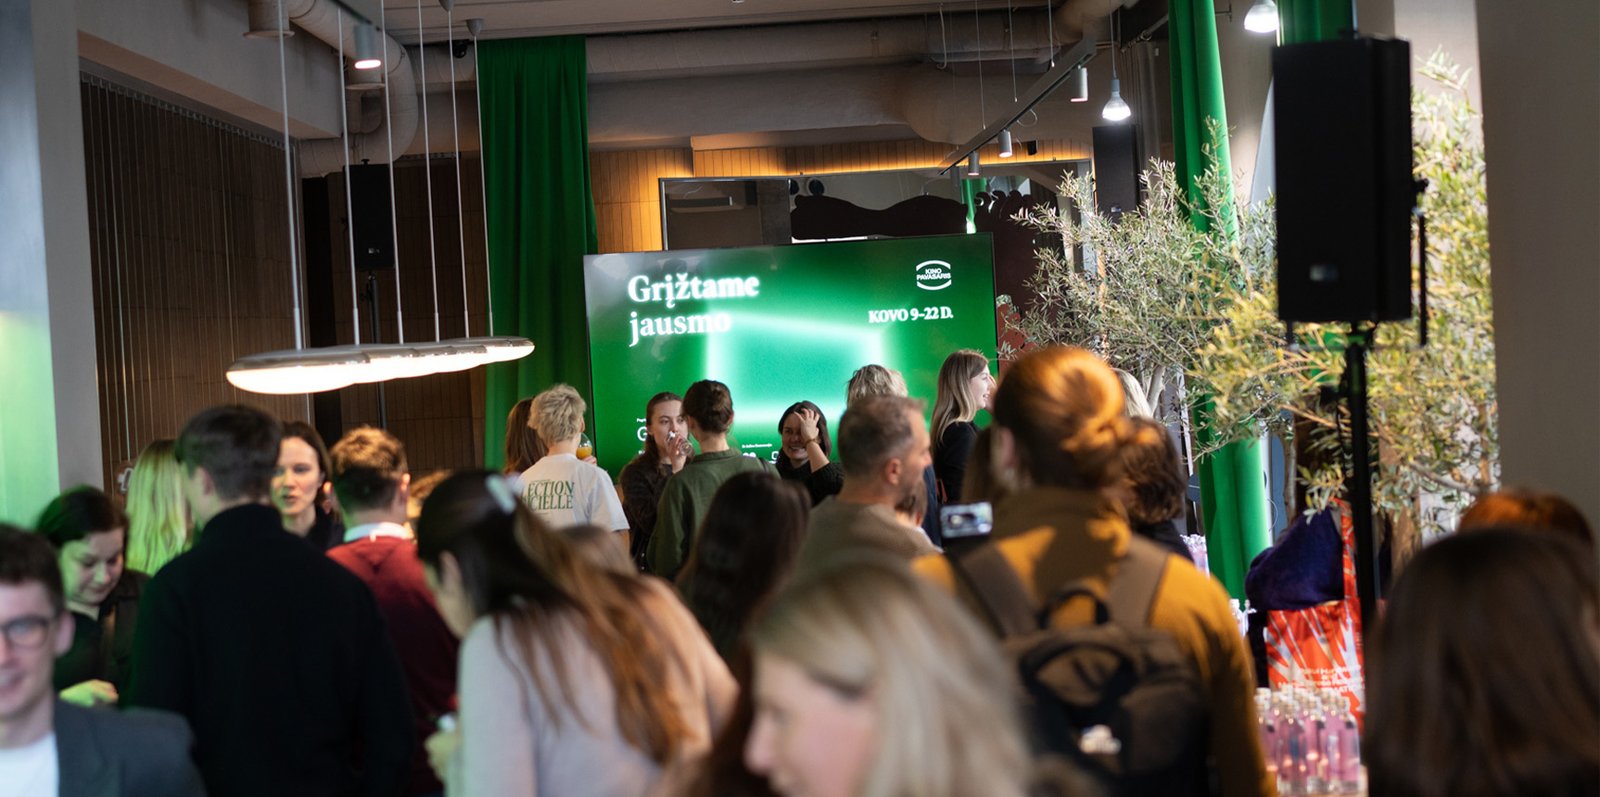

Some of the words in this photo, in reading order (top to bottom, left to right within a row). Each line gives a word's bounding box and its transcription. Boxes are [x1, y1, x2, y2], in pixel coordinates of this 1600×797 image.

[627, 272, 760, 309] Grįžtame
[628, 311, 732, 347] jausmo
[868, 308, 909, 323] KOVO
[940, 305, 954, 320] D.
